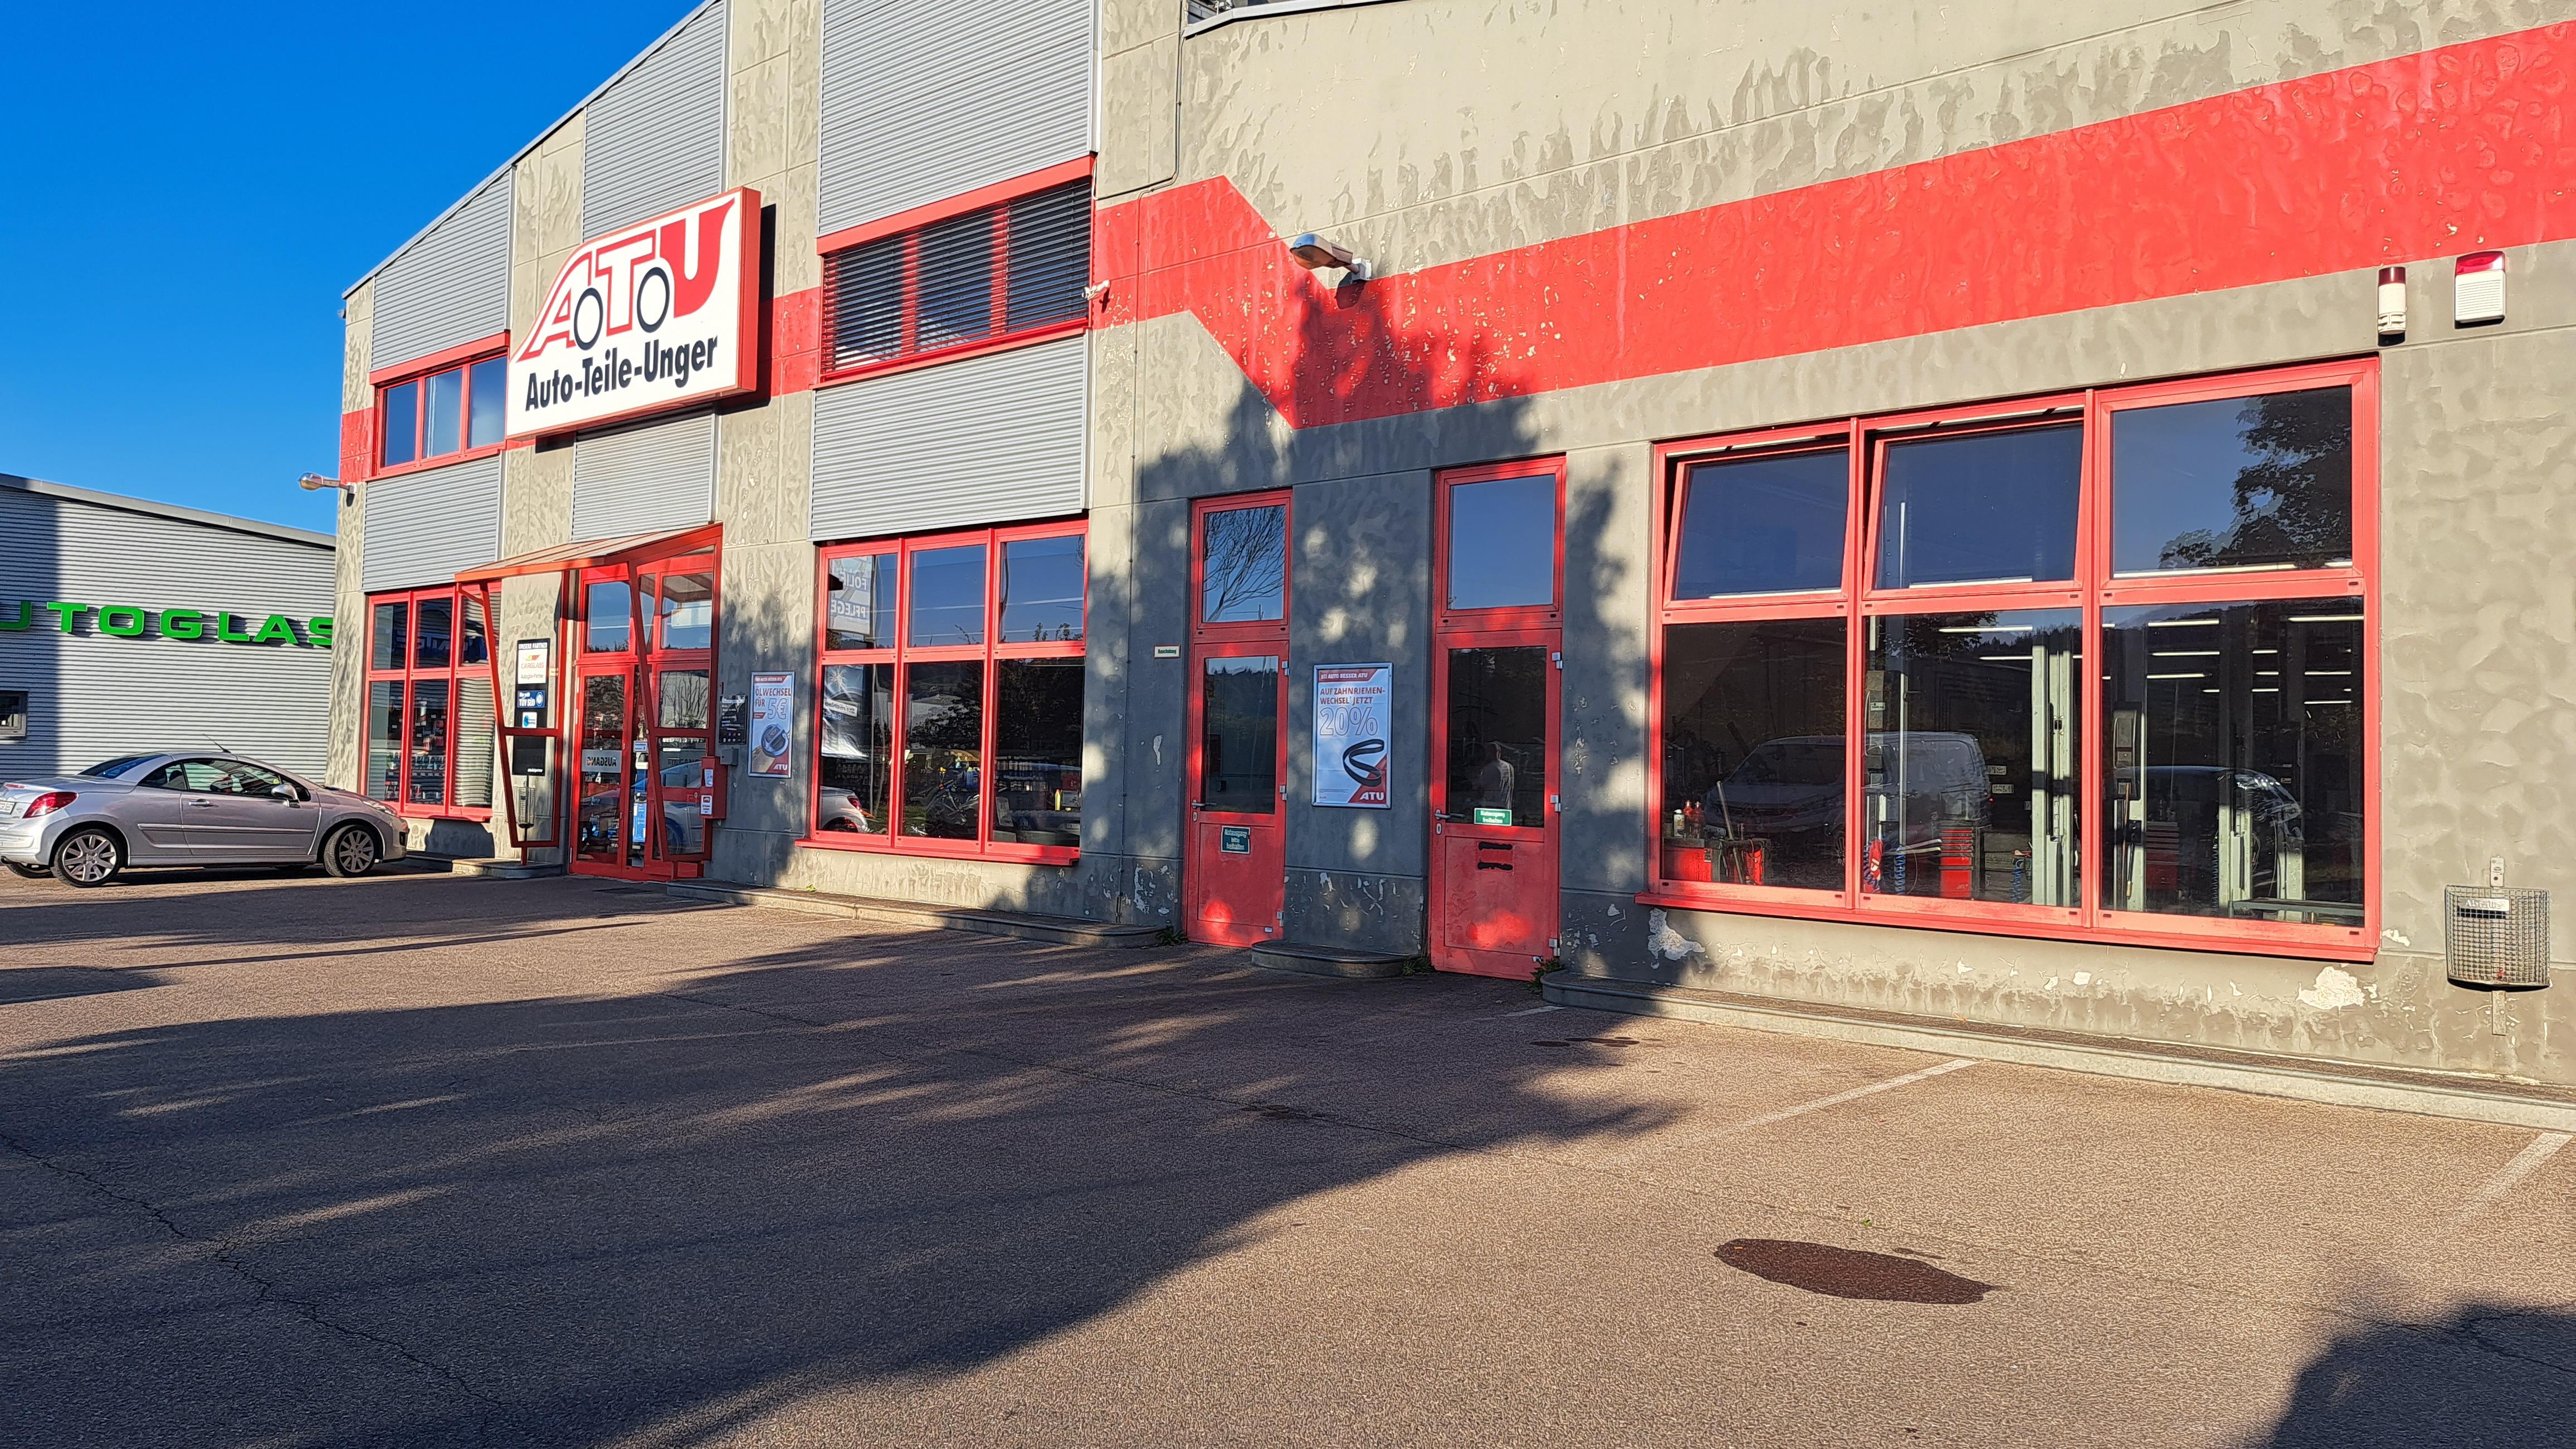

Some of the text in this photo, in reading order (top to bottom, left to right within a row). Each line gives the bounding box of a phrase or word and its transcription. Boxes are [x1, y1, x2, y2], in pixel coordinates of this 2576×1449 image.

[525, 335, 718, 412] Auto-Teile-Unger
[755, 686, 792, 696] ÖLWECHSEL
[1334, 686, 1385, 695] ZAHNRIEMEN-
[1353, 697, 1373, 706] JETZT
[755, 696, 787, 720] FÜR 5€
[1320, 706, 1378, 735] 20%
[1359, 792, 1384, 801] ATU
